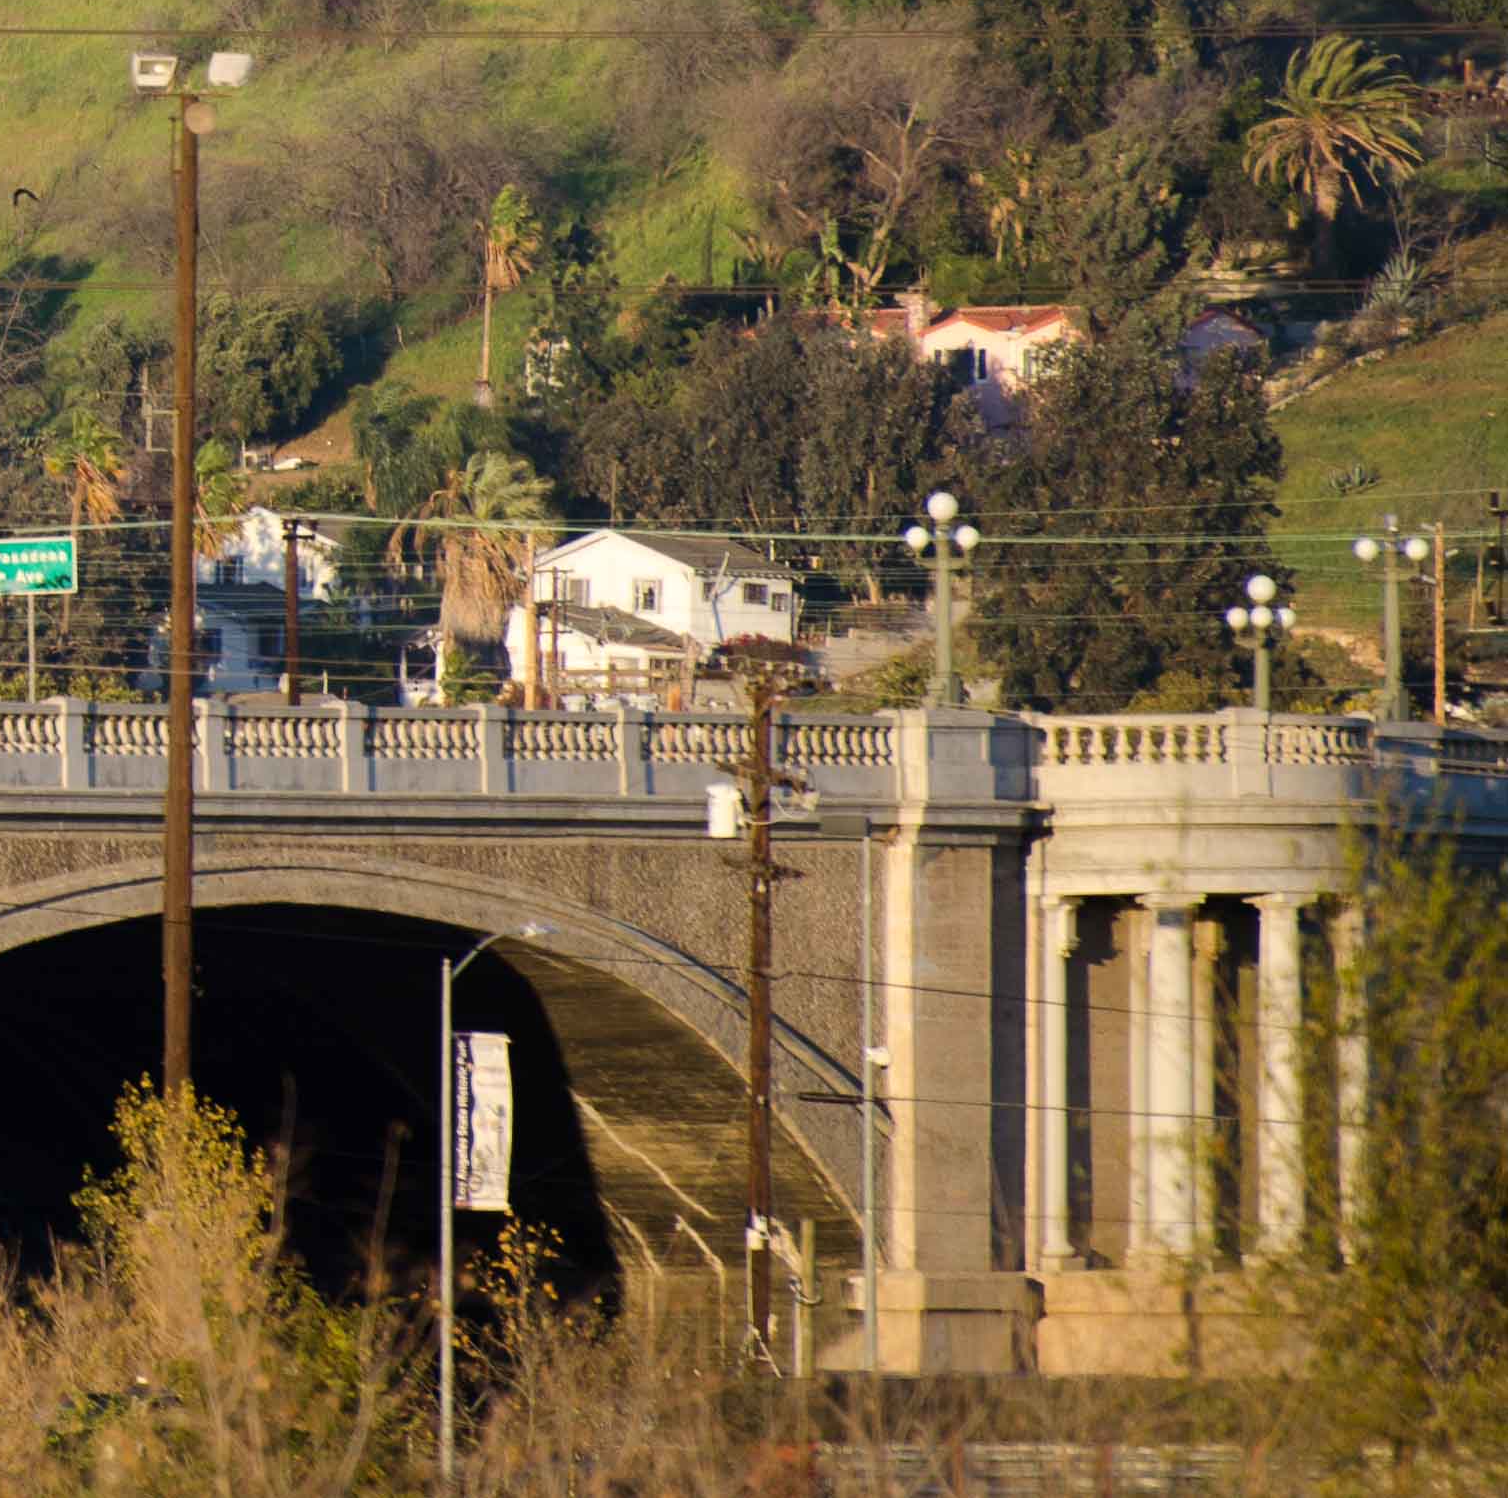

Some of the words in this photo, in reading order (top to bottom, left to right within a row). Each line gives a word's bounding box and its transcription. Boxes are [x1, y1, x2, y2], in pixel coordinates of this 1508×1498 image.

[16, 569, 45, 583] Ave
[456, 1108, 468, 1137] State
[456, 1138, 469, 1180] Angeles
[456, 1181, 468, 1200] Los
